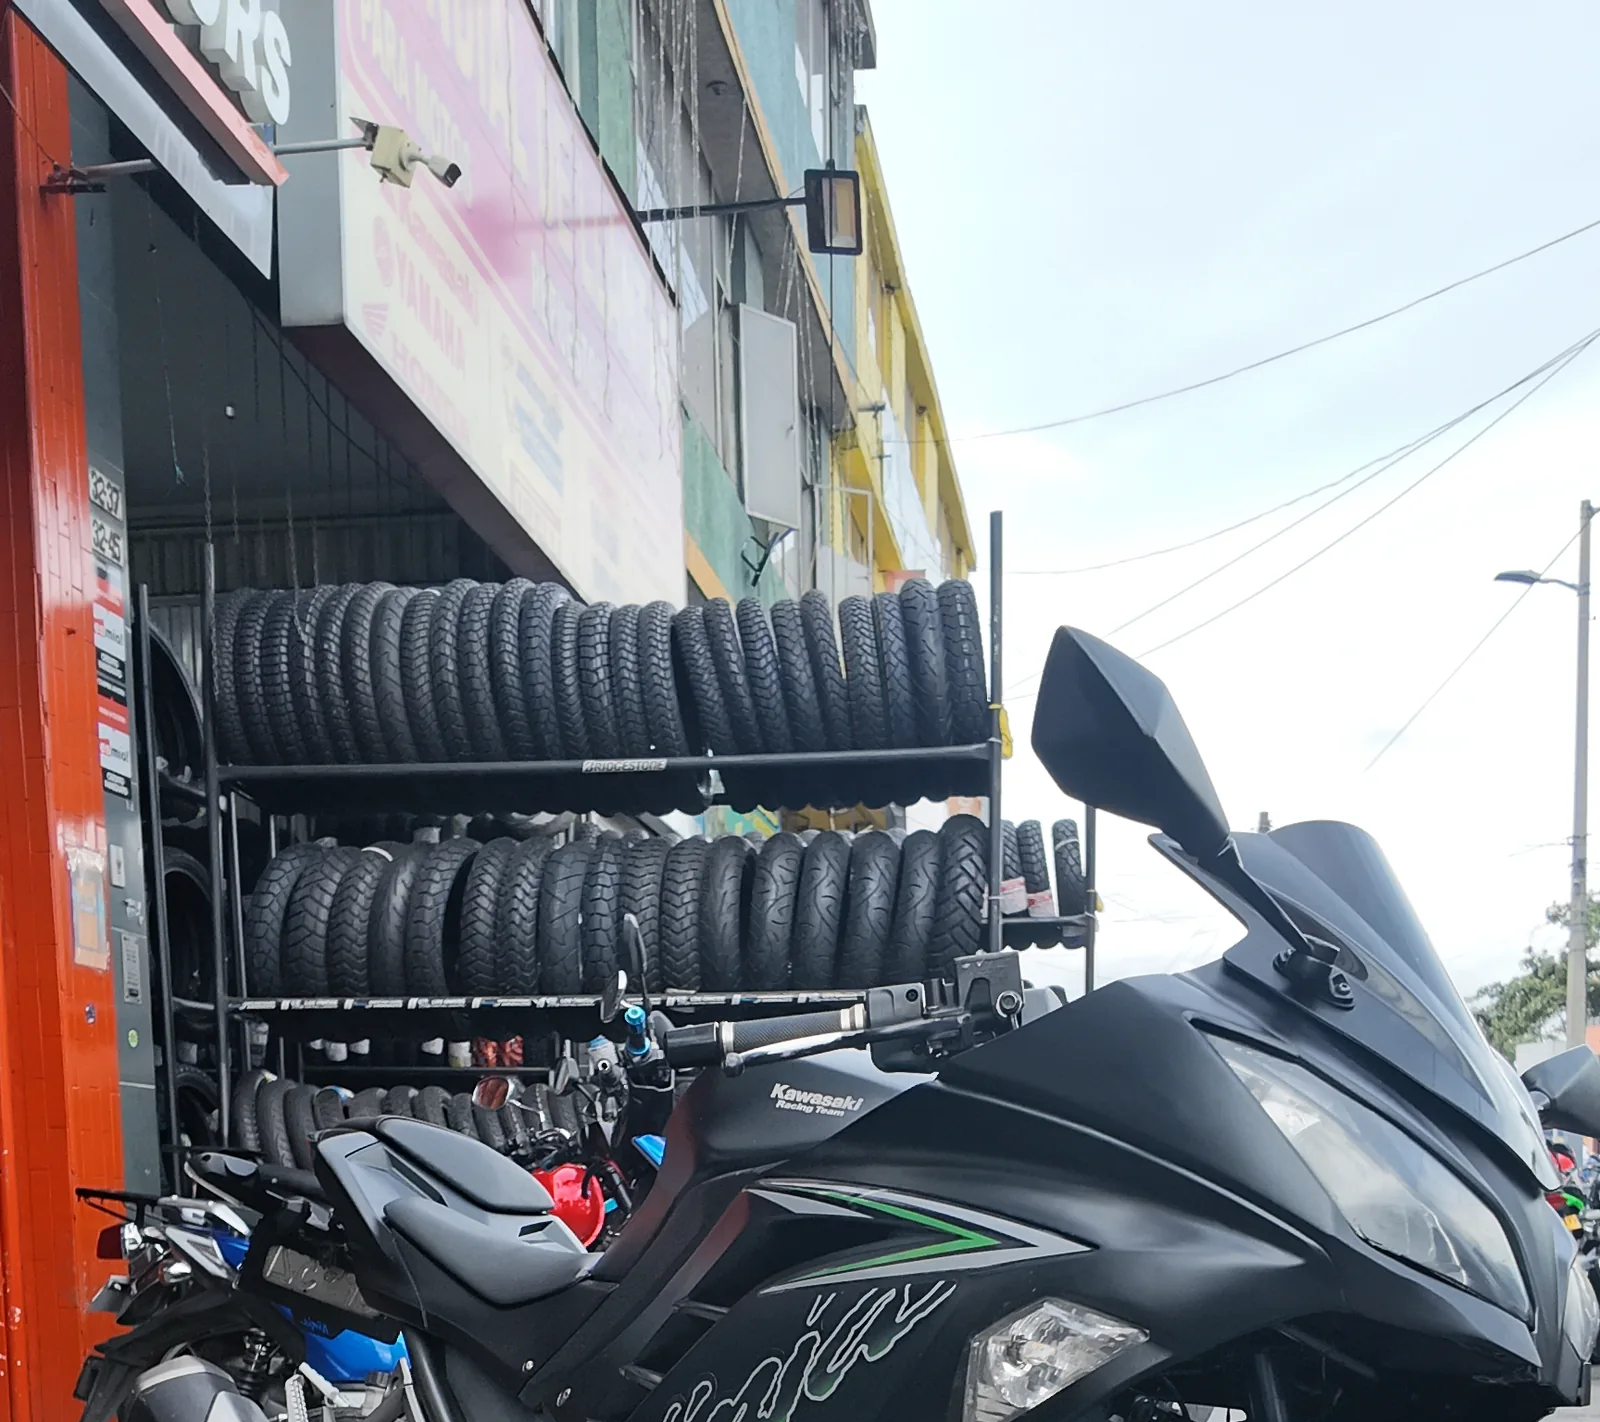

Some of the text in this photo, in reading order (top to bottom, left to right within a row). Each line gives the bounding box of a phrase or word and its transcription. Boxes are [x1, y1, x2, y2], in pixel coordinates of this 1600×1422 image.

[395, 240, 466, 380] YAMAHA
[583, 759, 667, 772] BRIDGESTONE
[770, 1083, 864, 1111] Kawasaki
[775, 1100, 845, 1117] Racing Team
